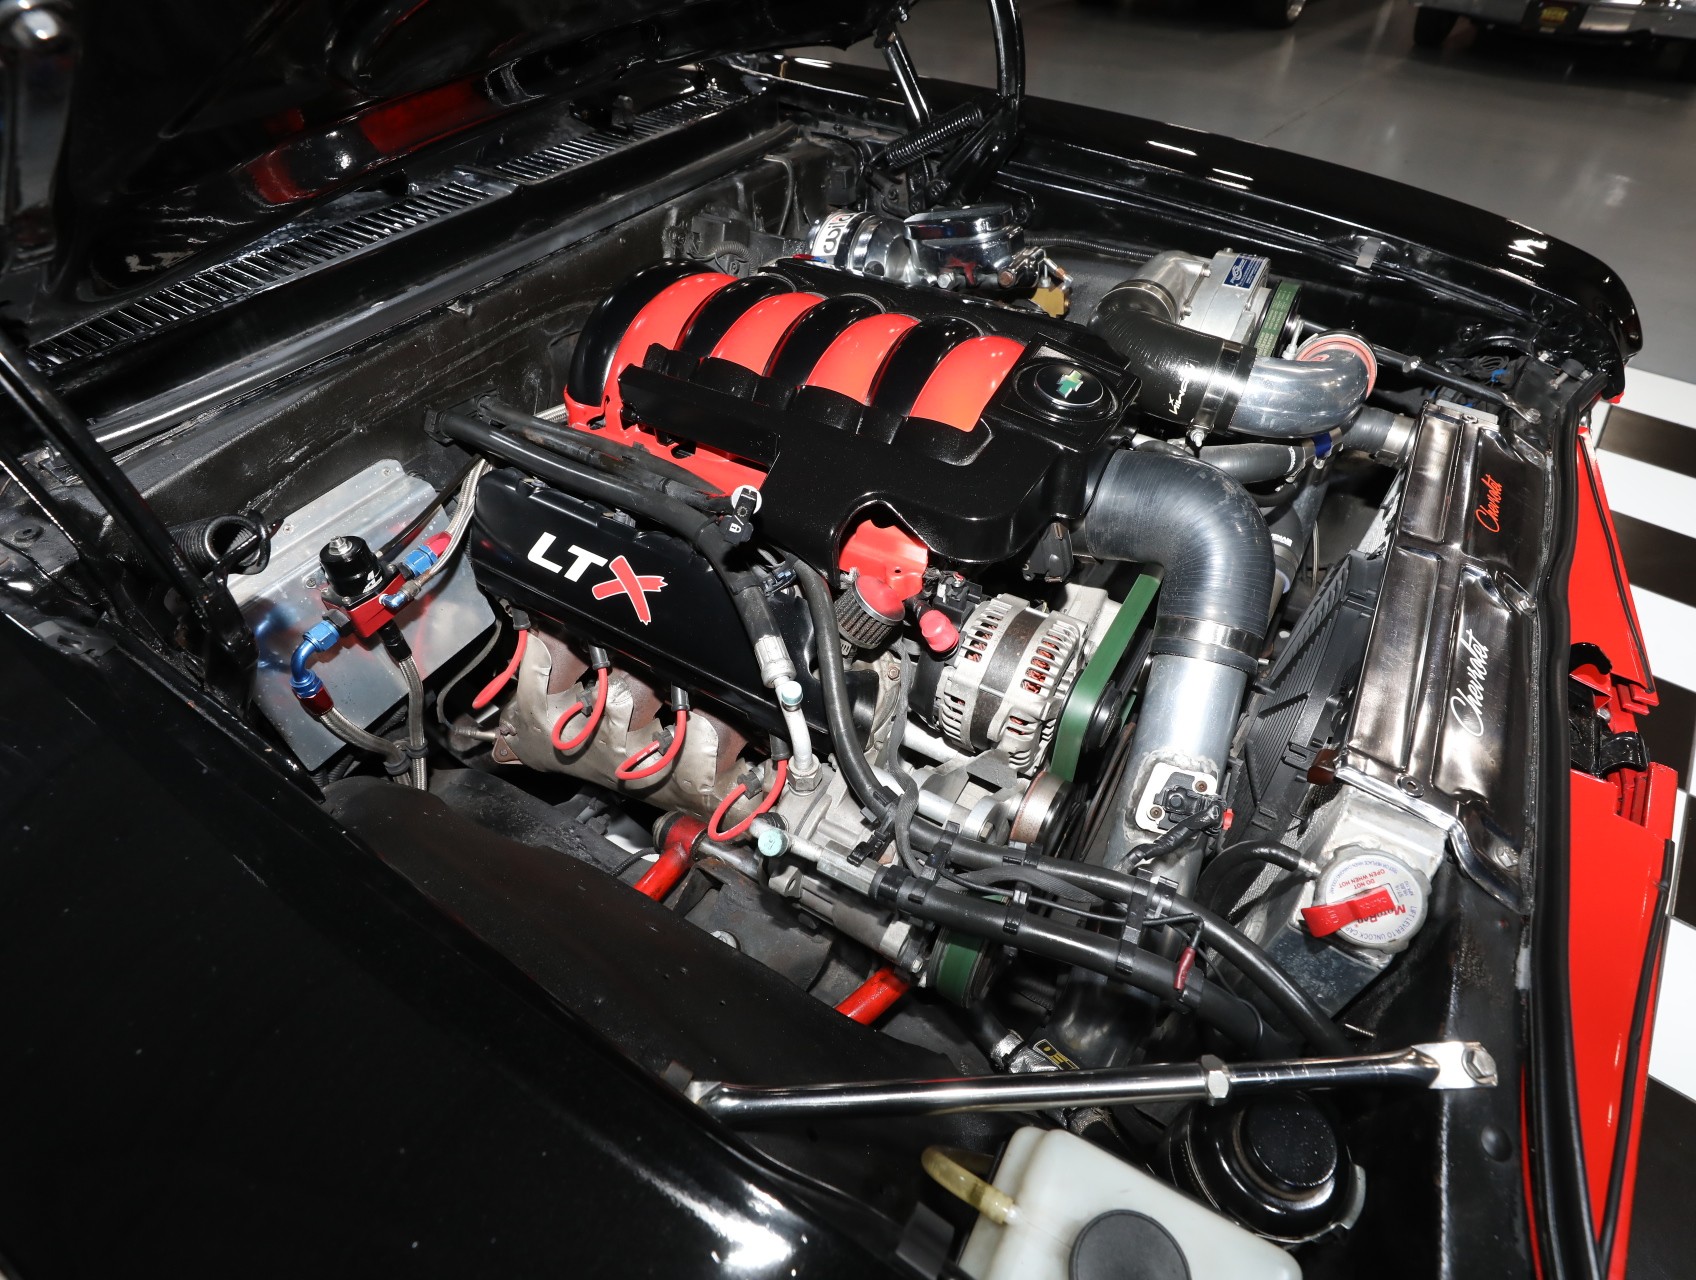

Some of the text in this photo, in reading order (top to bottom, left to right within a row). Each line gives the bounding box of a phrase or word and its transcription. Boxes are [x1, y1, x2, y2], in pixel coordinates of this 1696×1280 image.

[1476, 474, 1502, 533] Chevrolet
[527, 531, 668, 626] LTX
[1450, 628, 1489, 737] Chevrolet
[1338, 868, 1386, 889] OPEN WHEN HOT
[1353, 878, 1376, 890] DO NOT
[1345, 905, 1417, 941] LIFT LEVER TO UNLOCK CAP
